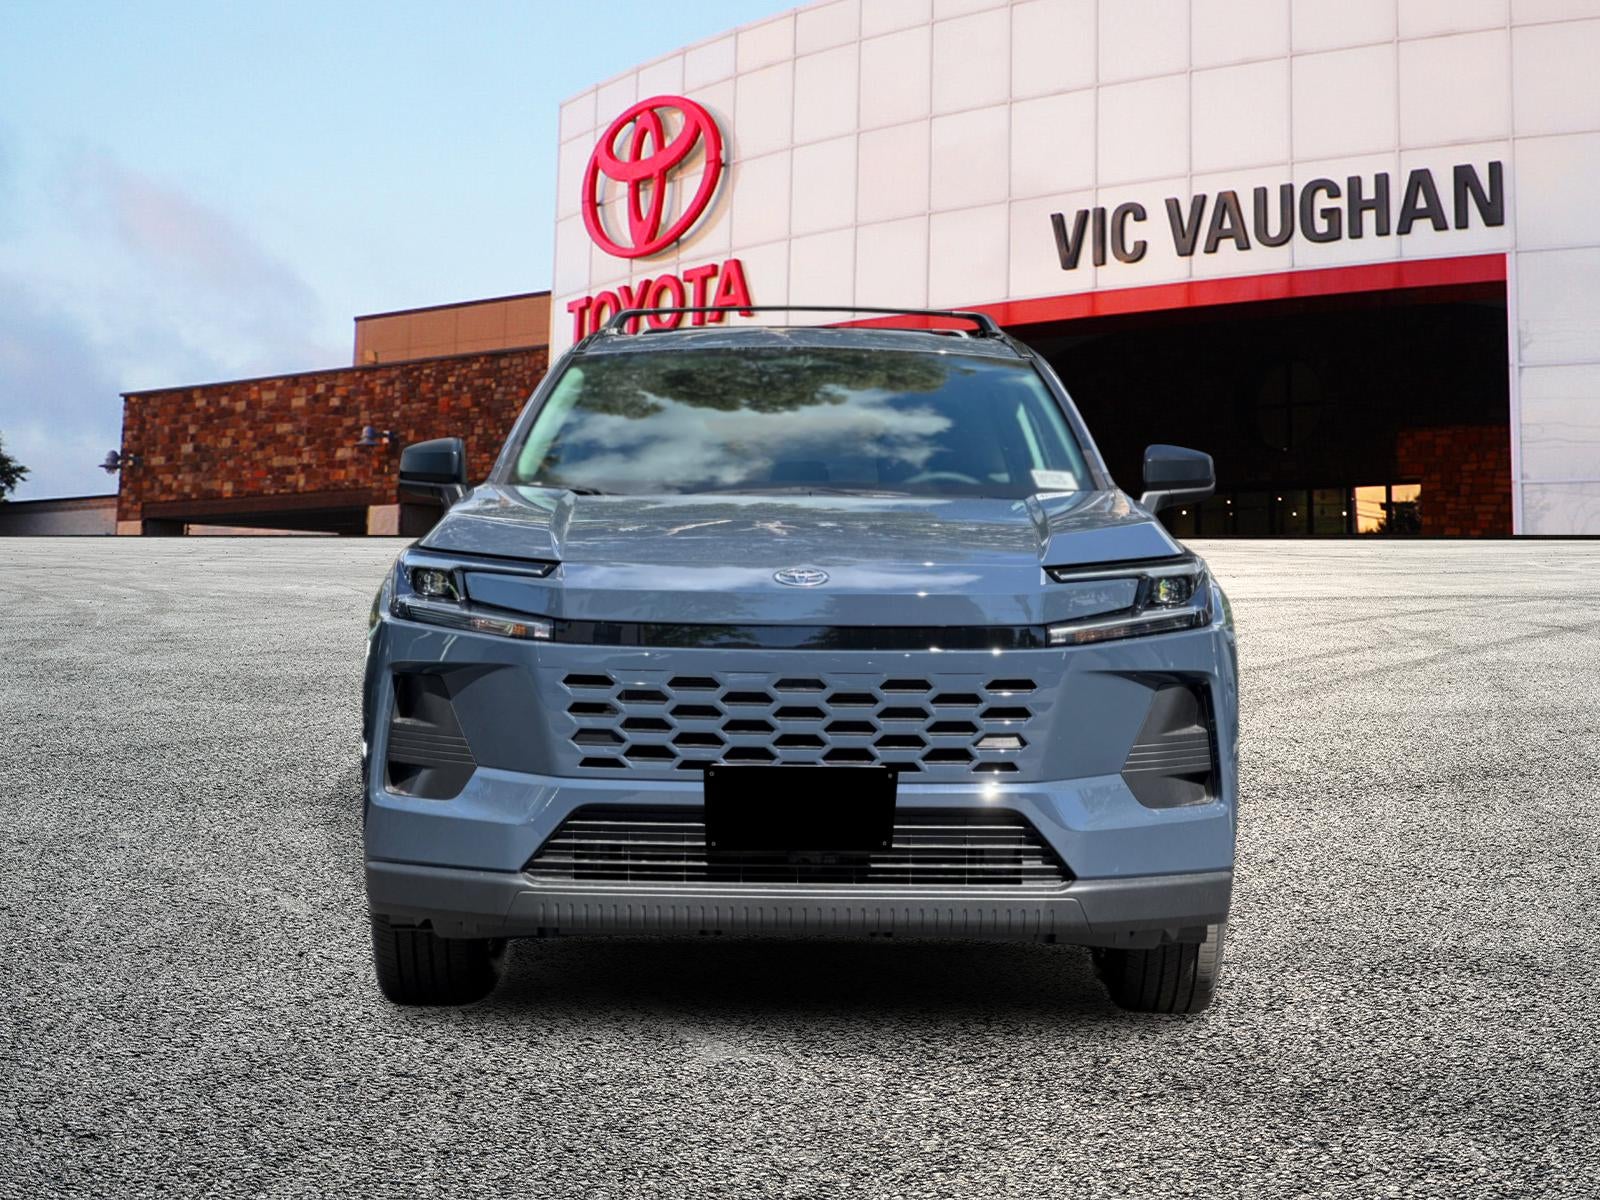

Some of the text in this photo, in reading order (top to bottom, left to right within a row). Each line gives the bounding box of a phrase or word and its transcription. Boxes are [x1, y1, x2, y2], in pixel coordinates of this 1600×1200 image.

[1050, 160, 1505, 270] VIC VAUGHAN
[567, 258, 754, 345] TOYOTA
